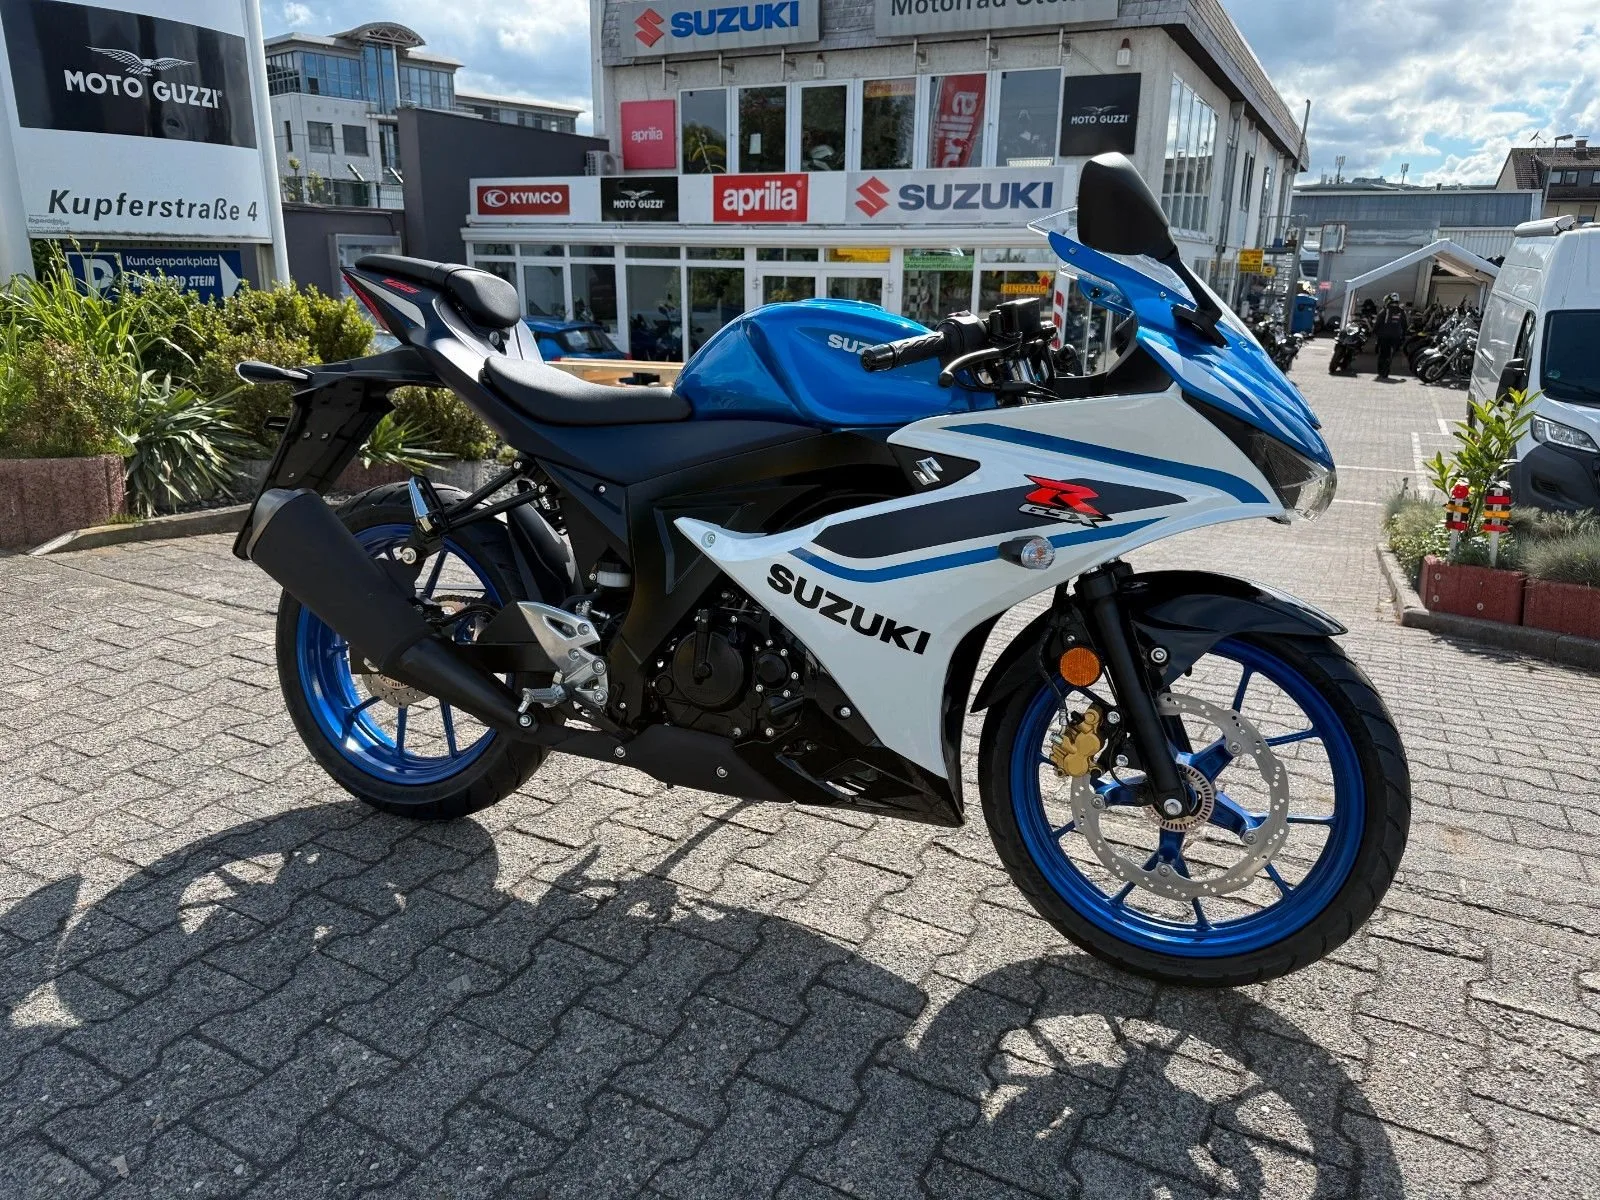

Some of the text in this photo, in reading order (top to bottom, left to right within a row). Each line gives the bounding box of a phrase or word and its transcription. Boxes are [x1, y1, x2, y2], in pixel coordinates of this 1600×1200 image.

[671, 1, 799, 38] SUZUKI
[63, 69, 220, 109] MOTO GUZZI
[1071, 114, 1128, 125] MOTO GUZZI
[631, 126, 664, 143] aprilia
[48, 188, 258, 222] Kupferstraße 4
[510, 192, 562, 204] KYMCO
[613, 199, 663, 209] MOTO GUZZI
[722, 180, 797, 216] aprilia
[897, 182, 1054, 211] SUZUKI
[126, 255, 218, 269] Kundenparkplatz
[189, 275, 215, 287] STEIN
[1003, 285, 1047, 293] EINGANG
[828, 334, 874, 356] SUZ
[767, 563, 931, 655] SUZUKI
